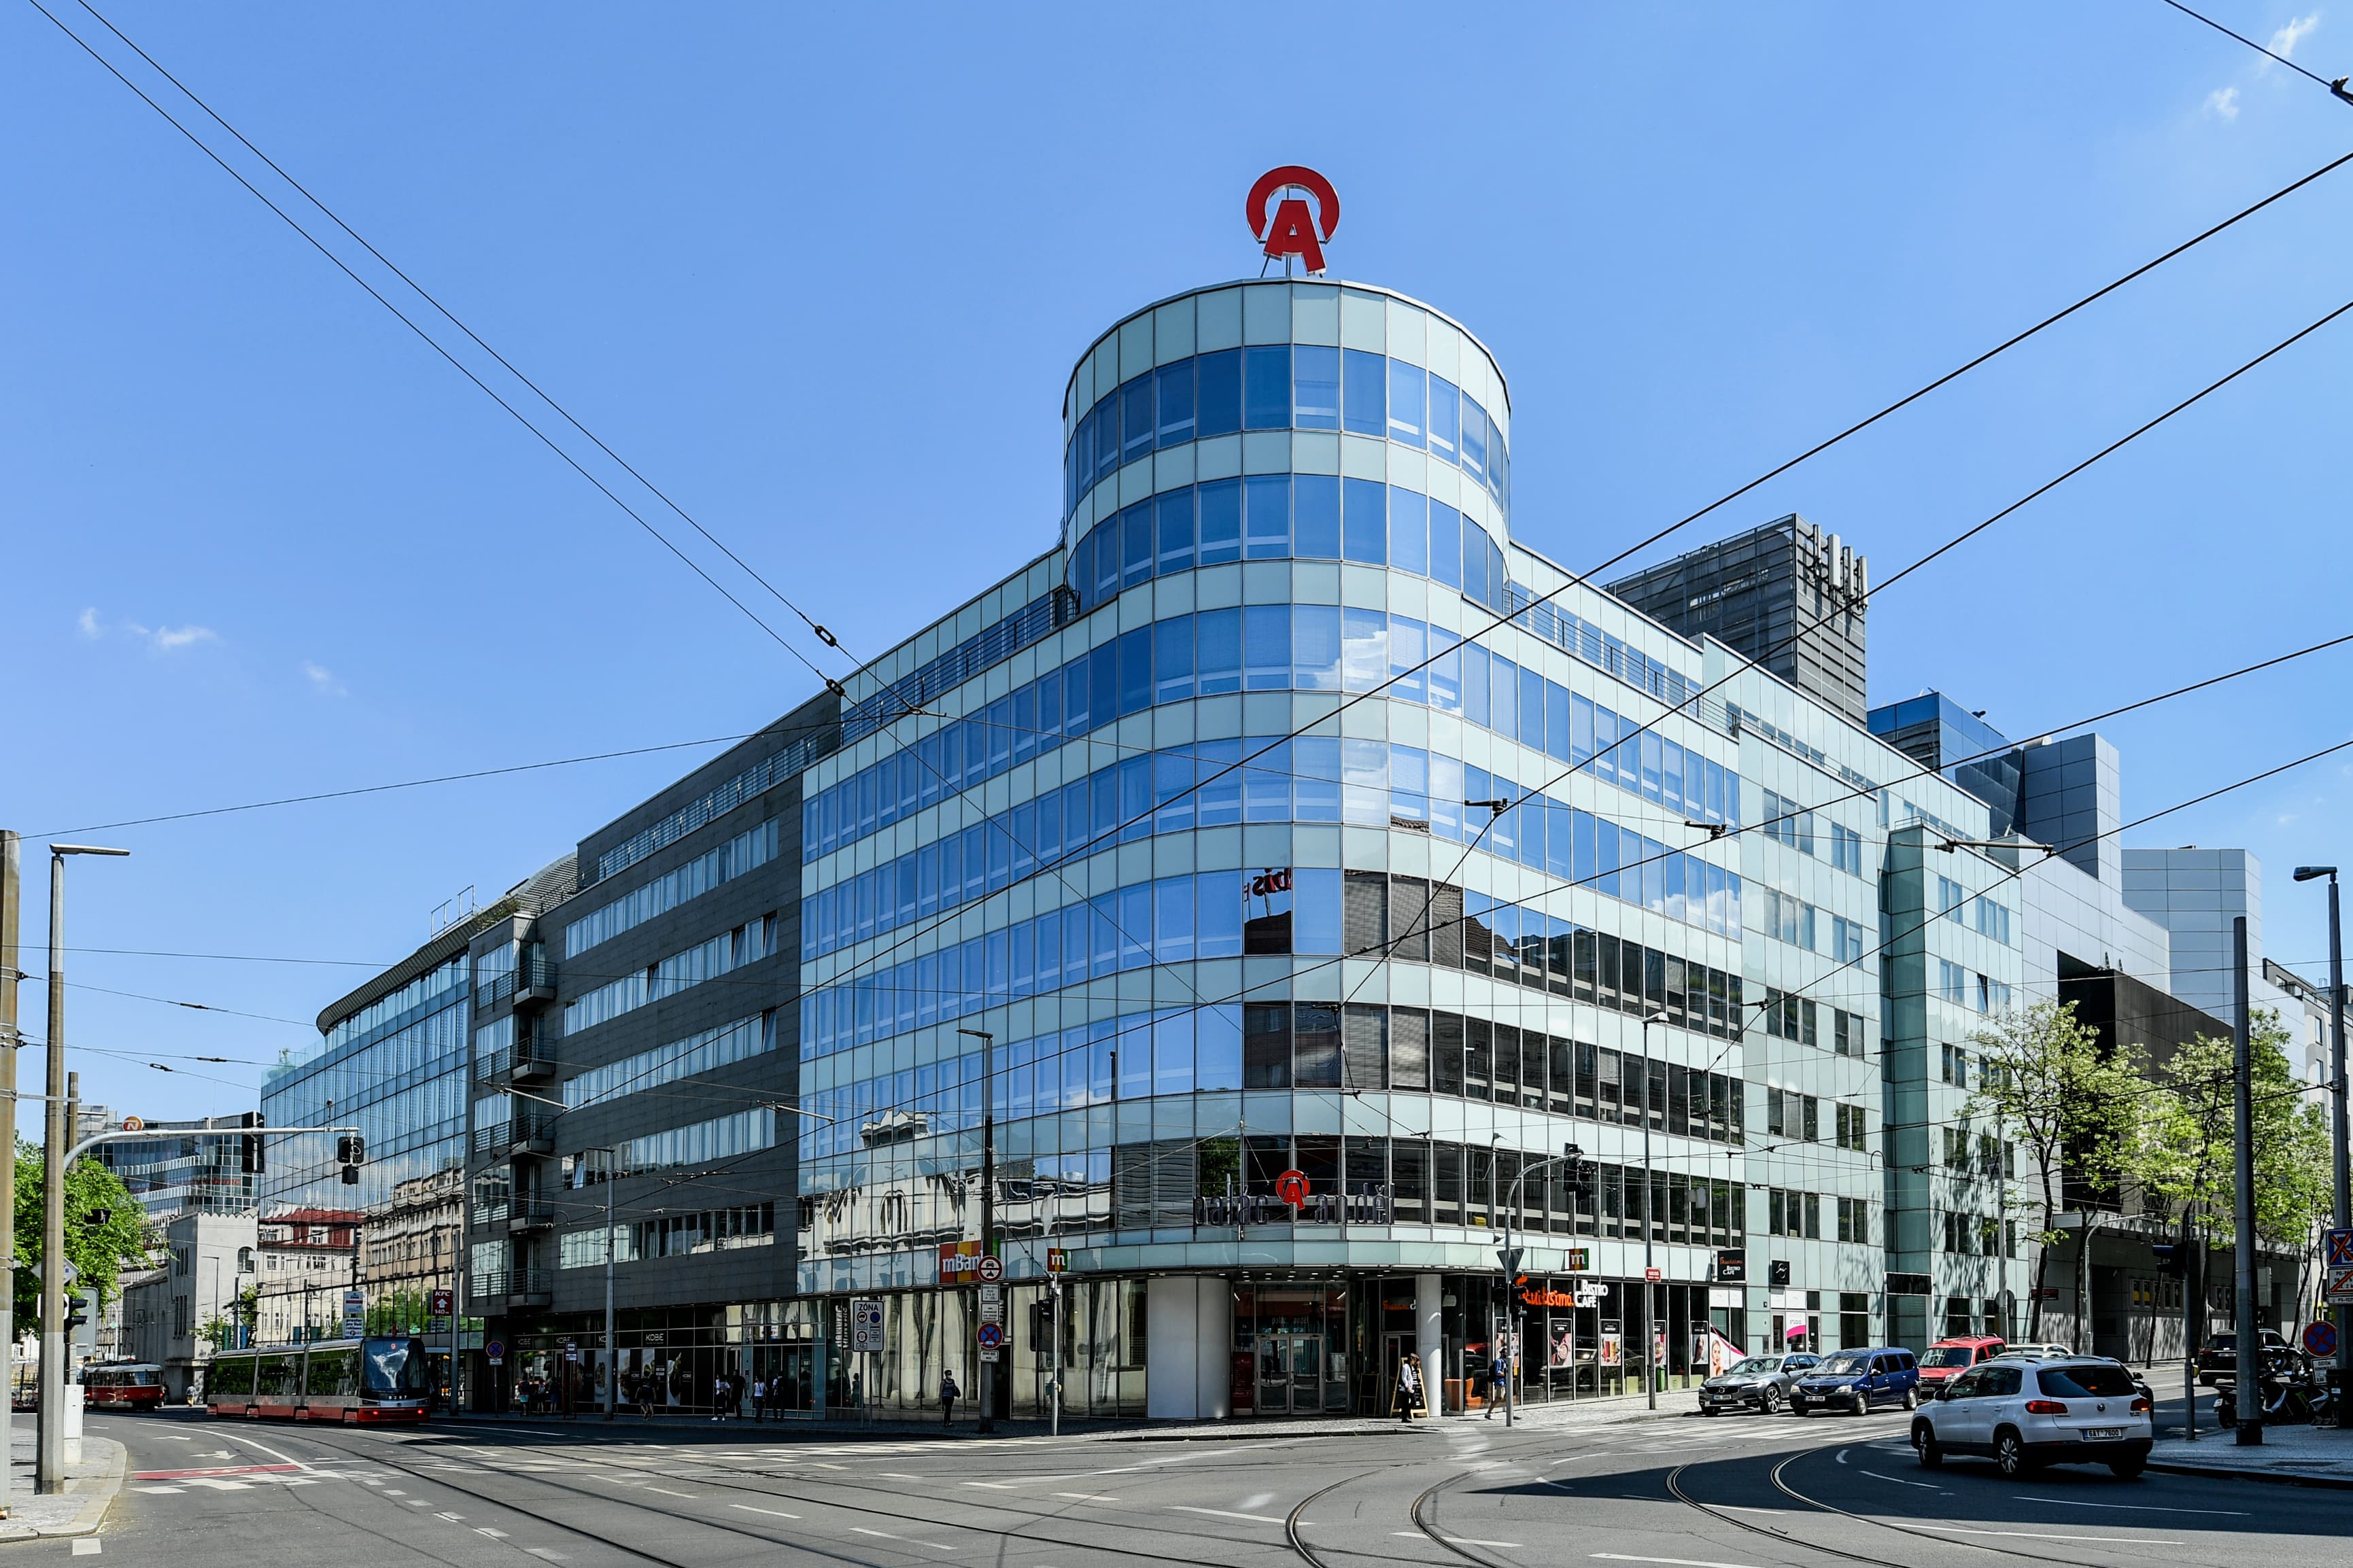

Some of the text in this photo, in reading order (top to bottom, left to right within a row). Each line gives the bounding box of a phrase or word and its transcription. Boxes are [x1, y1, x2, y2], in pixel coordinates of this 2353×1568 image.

[1193, 1183, 1395, 1234] palác anděl
[942, 1250, 983, 1273] mBan
[1051, 1253, 1065, 1266] m
[1570, 1253, 1585, 1265] m
[859, 1302, 878, 1311] ZÓNA
